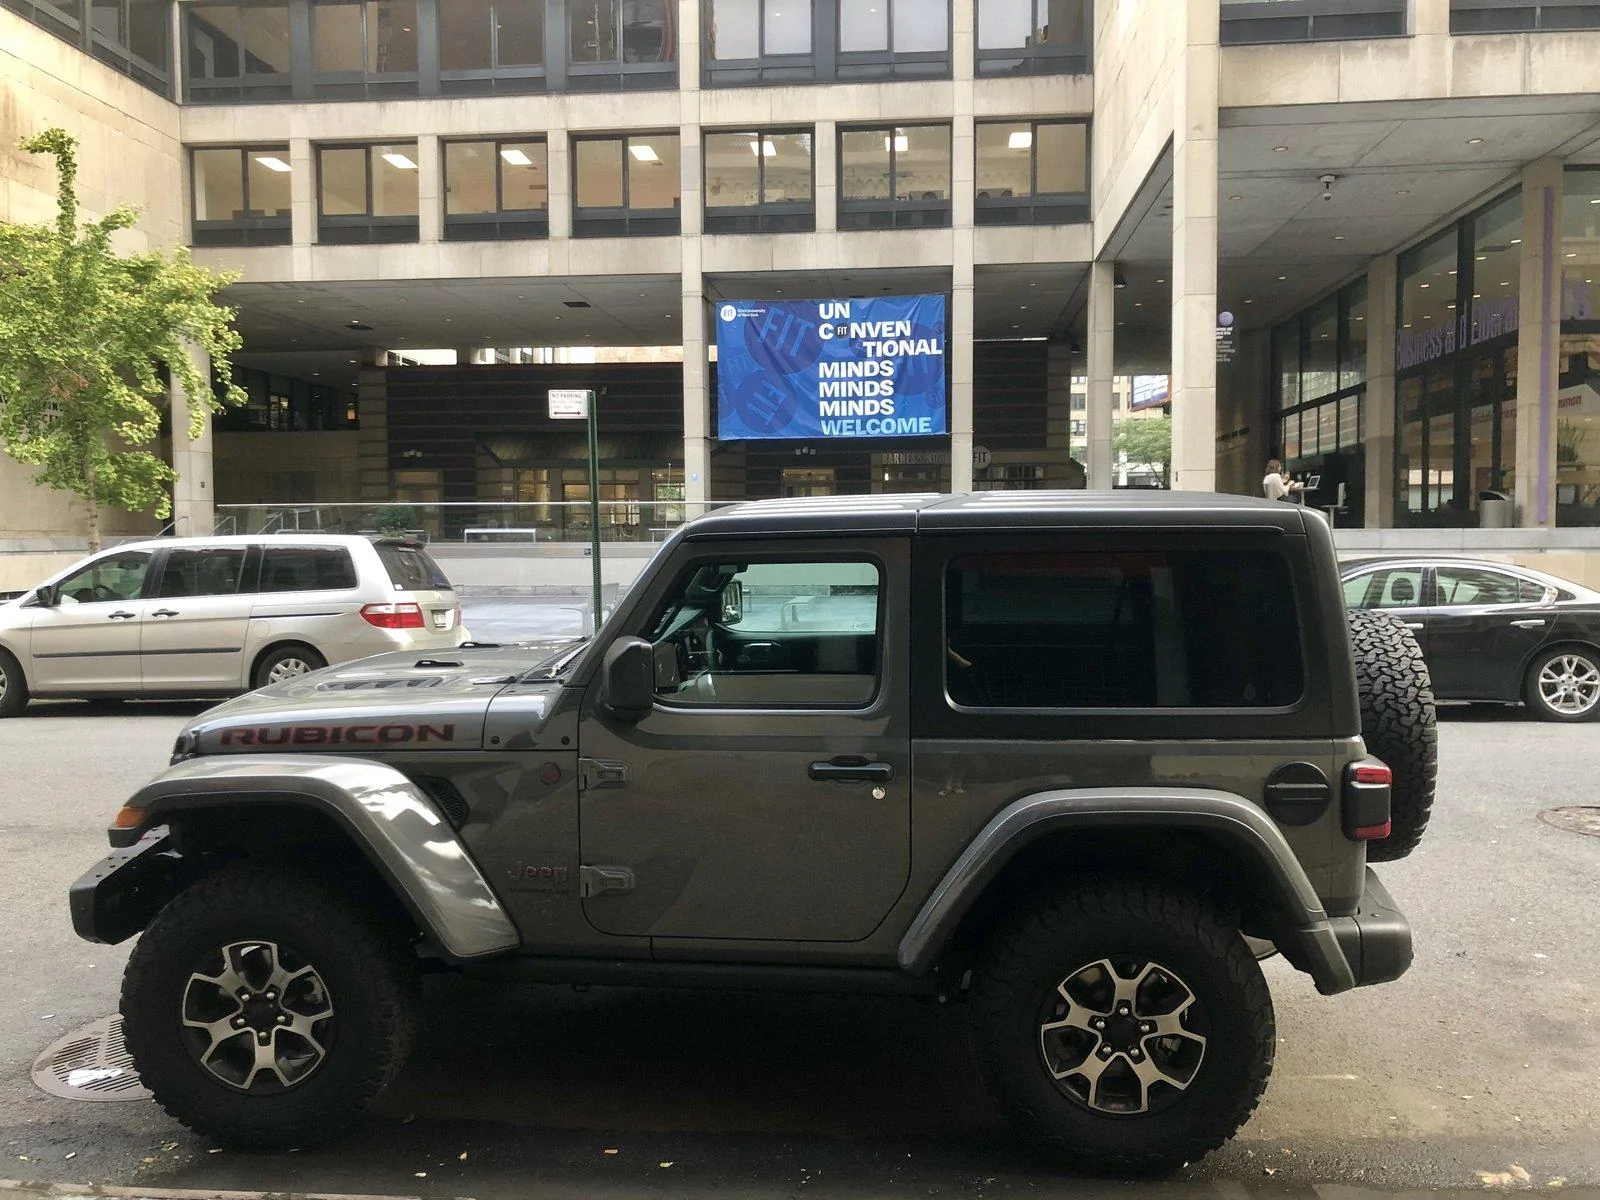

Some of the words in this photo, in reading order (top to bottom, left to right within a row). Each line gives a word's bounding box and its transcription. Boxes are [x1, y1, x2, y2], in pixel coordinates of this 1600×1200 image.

[819, 302, 851, 320] UN
[862, 338, 943, 358] TIONAL
[819, 360, 895, 379] MINDS
[819, 380, 895, 398] MINDS
[819, 399, 895, 417] MINDS
[821, 416, 932, 436] WELCOME
[219, 724, 455, 746] RUBICON
[507, 861, 570, 883] Jeep
